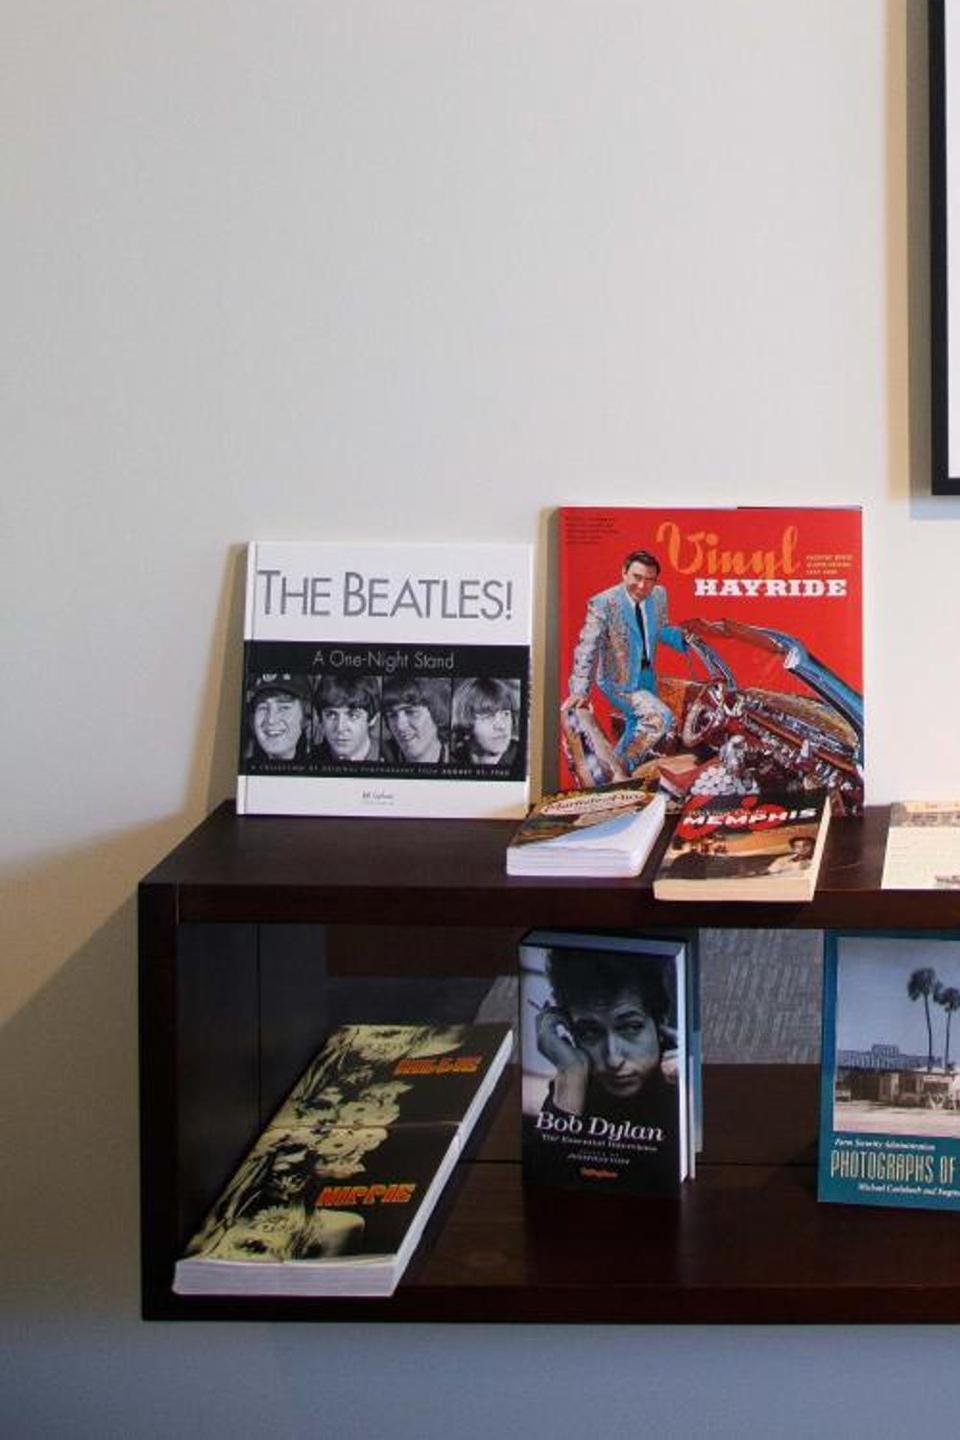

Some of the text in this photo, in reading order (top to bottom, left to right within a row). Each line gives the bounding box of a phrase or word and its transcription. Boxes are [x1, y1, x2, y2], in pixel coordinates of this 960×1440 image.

[656, 521, 801, 578] Vinyl
[257, 569, 513, 621] THE BEATLES!
[694, 578, 848, 597] HAYRIDE
[312, 649, 455, 673] A One-Night Stand
[682, 807, 818, 826] MEMPHIS
[535, 1112, 664, 1142] Bob Dylan
[830, 1149, 935, 1185] PHOTOGRAPHS
[940, 1155, 956, 1185] OF
